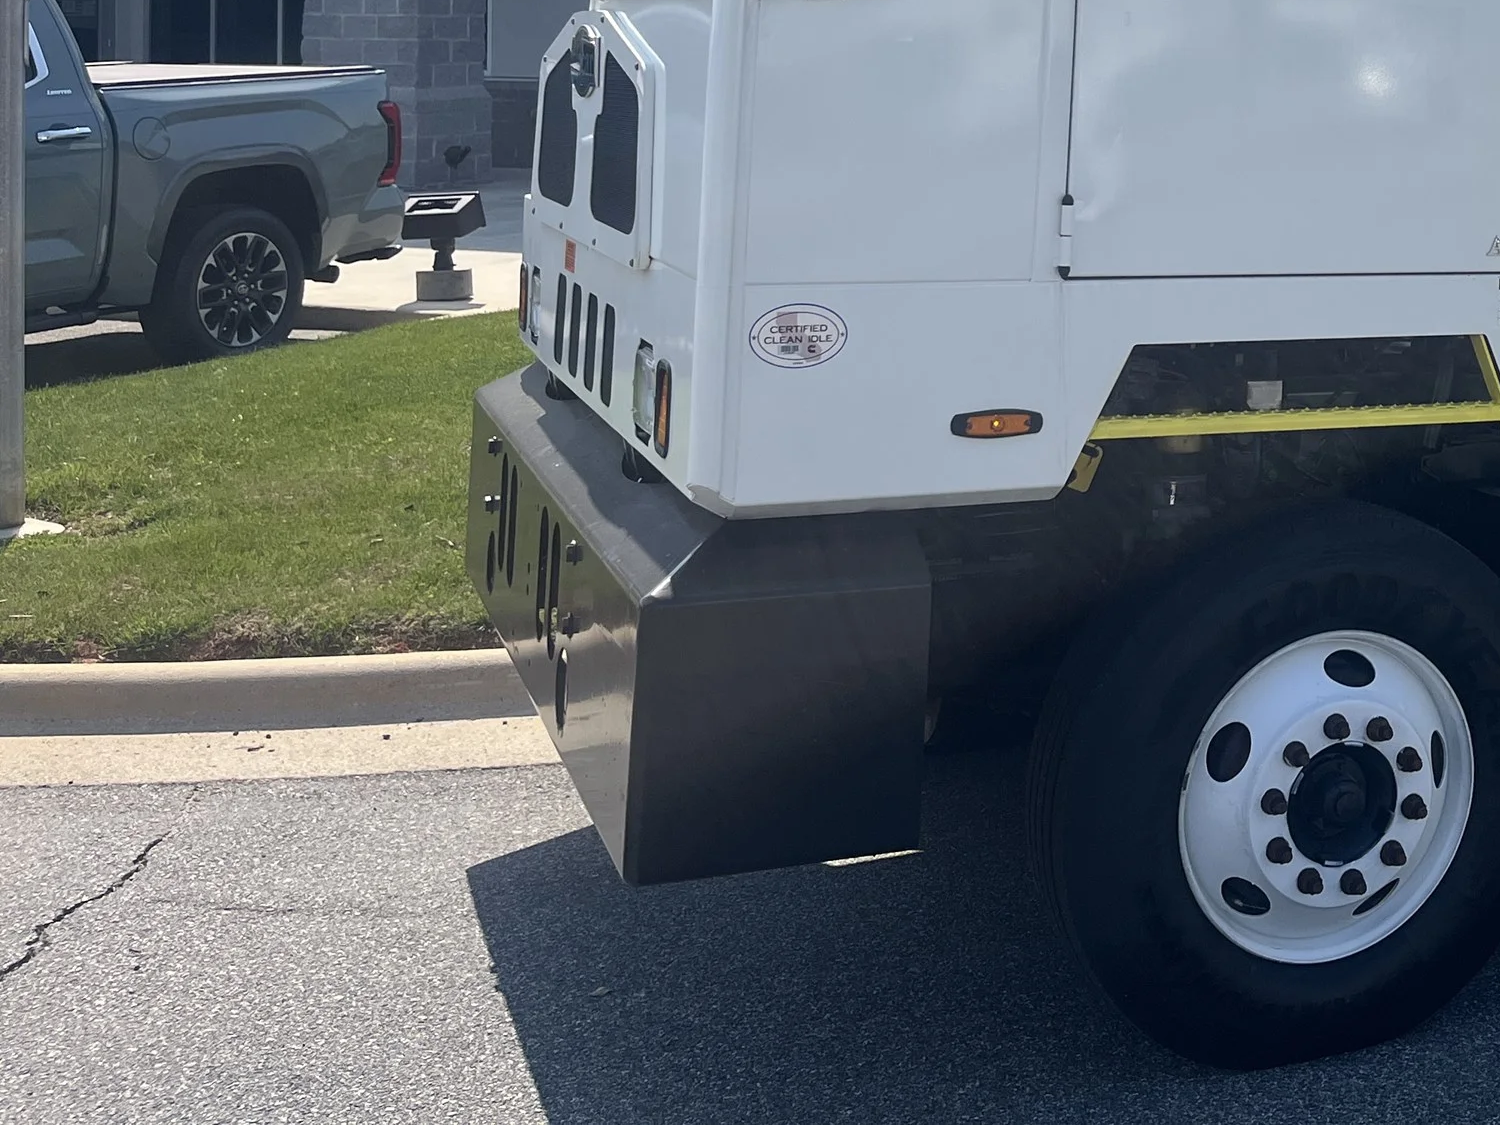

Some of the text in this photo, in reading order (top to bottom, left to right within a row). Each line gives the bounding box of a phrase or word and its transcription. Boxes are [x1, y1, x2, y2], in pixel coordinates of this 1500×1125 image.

[769, 324, 828, 334] CERTIFIED
[764, 334, 833, 345] CLEAN IDLE
